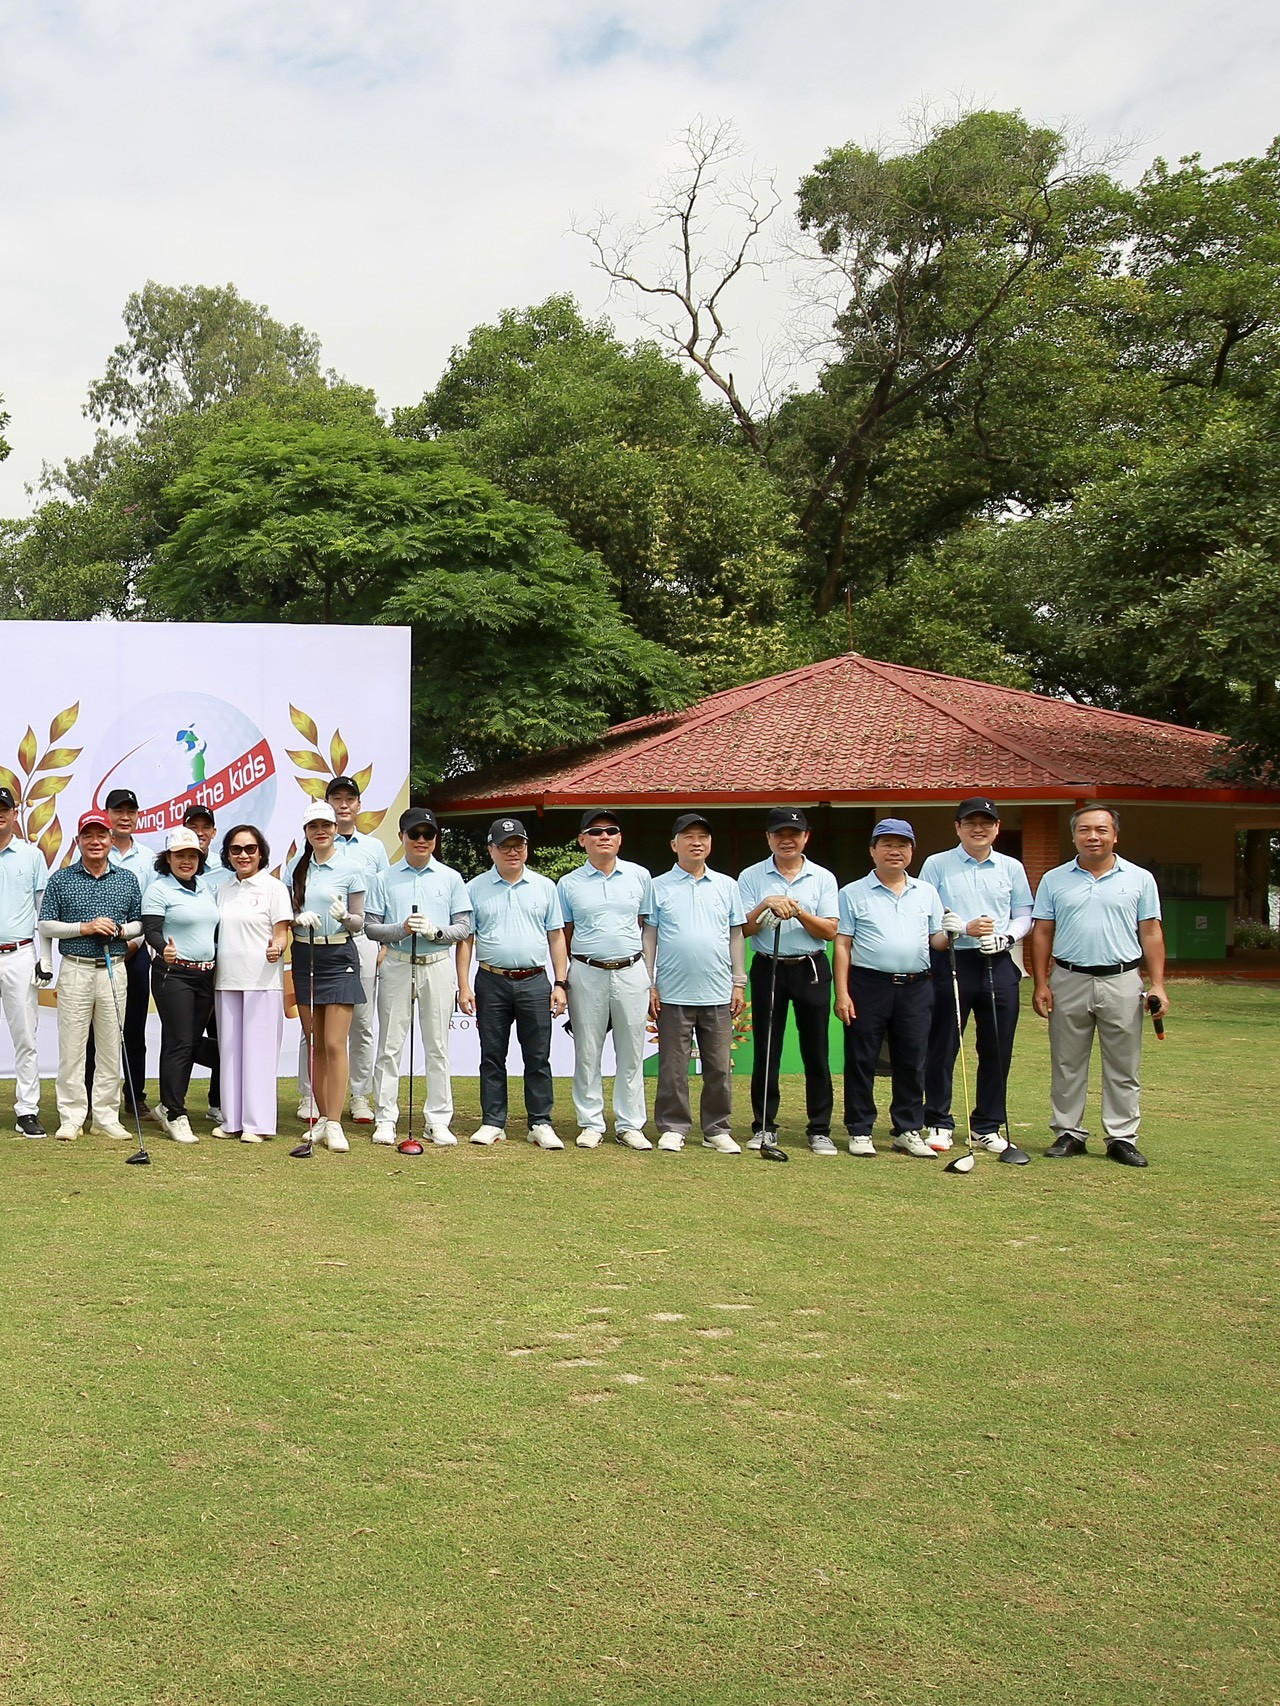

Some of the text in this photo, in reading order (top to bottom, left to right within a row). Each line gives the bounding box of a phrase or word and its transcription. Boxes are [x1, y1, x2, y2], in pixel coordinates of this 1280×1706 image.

[136, 753, 267, 831] wing for the kids
